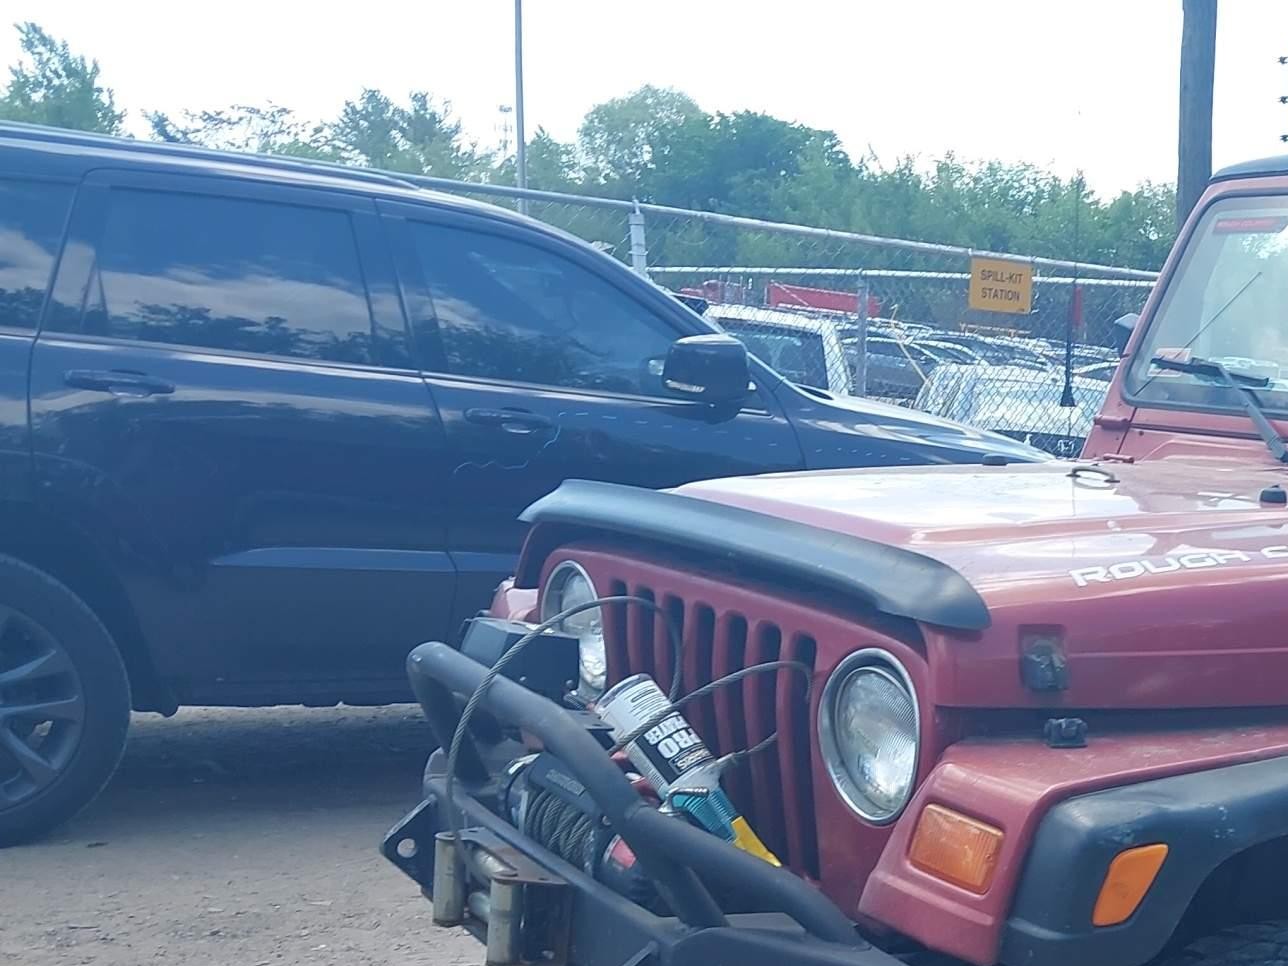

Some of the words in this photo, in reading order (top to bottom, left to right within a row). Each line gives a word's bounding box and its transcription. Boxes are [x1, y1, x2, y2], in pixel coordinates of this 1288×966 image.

[980, 268, 1024, 284] SPILL-KIT
[981, 286, 1020, 302] STATION
[1068, 548, 1249, 587] ROUGH
